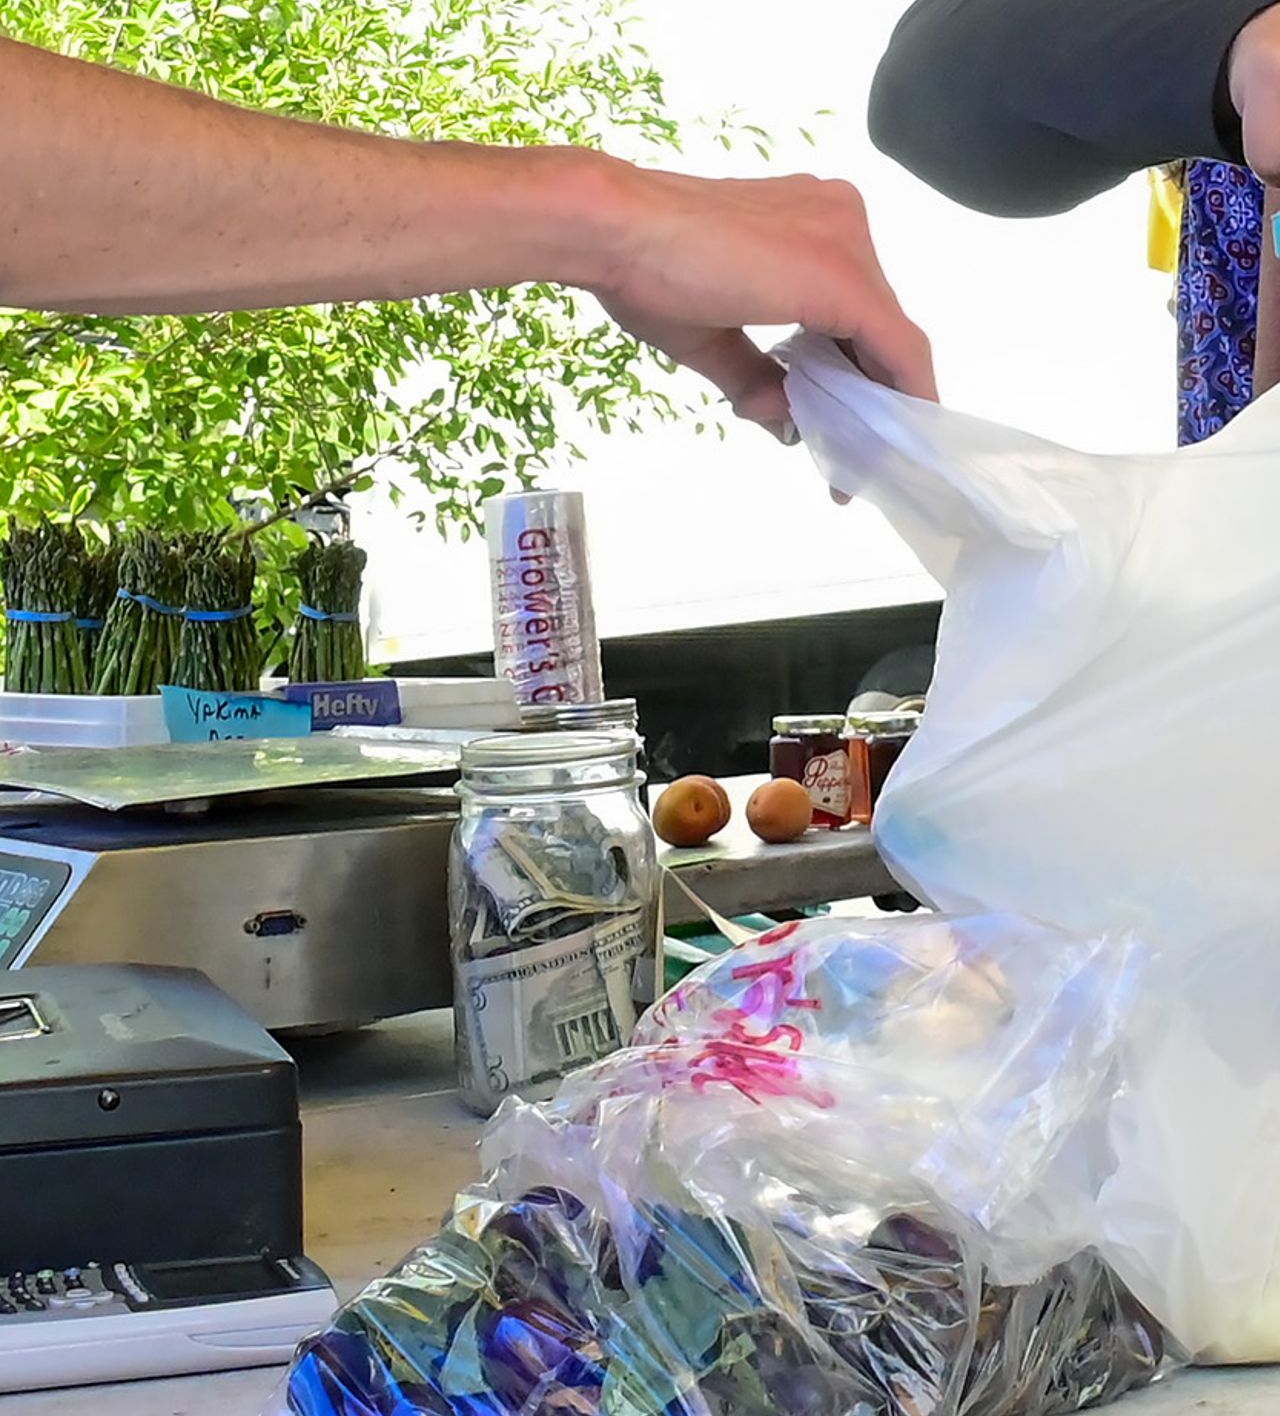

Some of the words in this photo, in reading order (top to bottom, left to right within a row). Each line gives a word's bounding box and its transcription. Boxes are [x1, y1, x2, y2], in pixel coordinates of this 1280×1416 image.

[518, 528, 559, 674] Grower's
[313, 692, 379, 717] Hefty
[488, 1055, 509, 1092] 5
